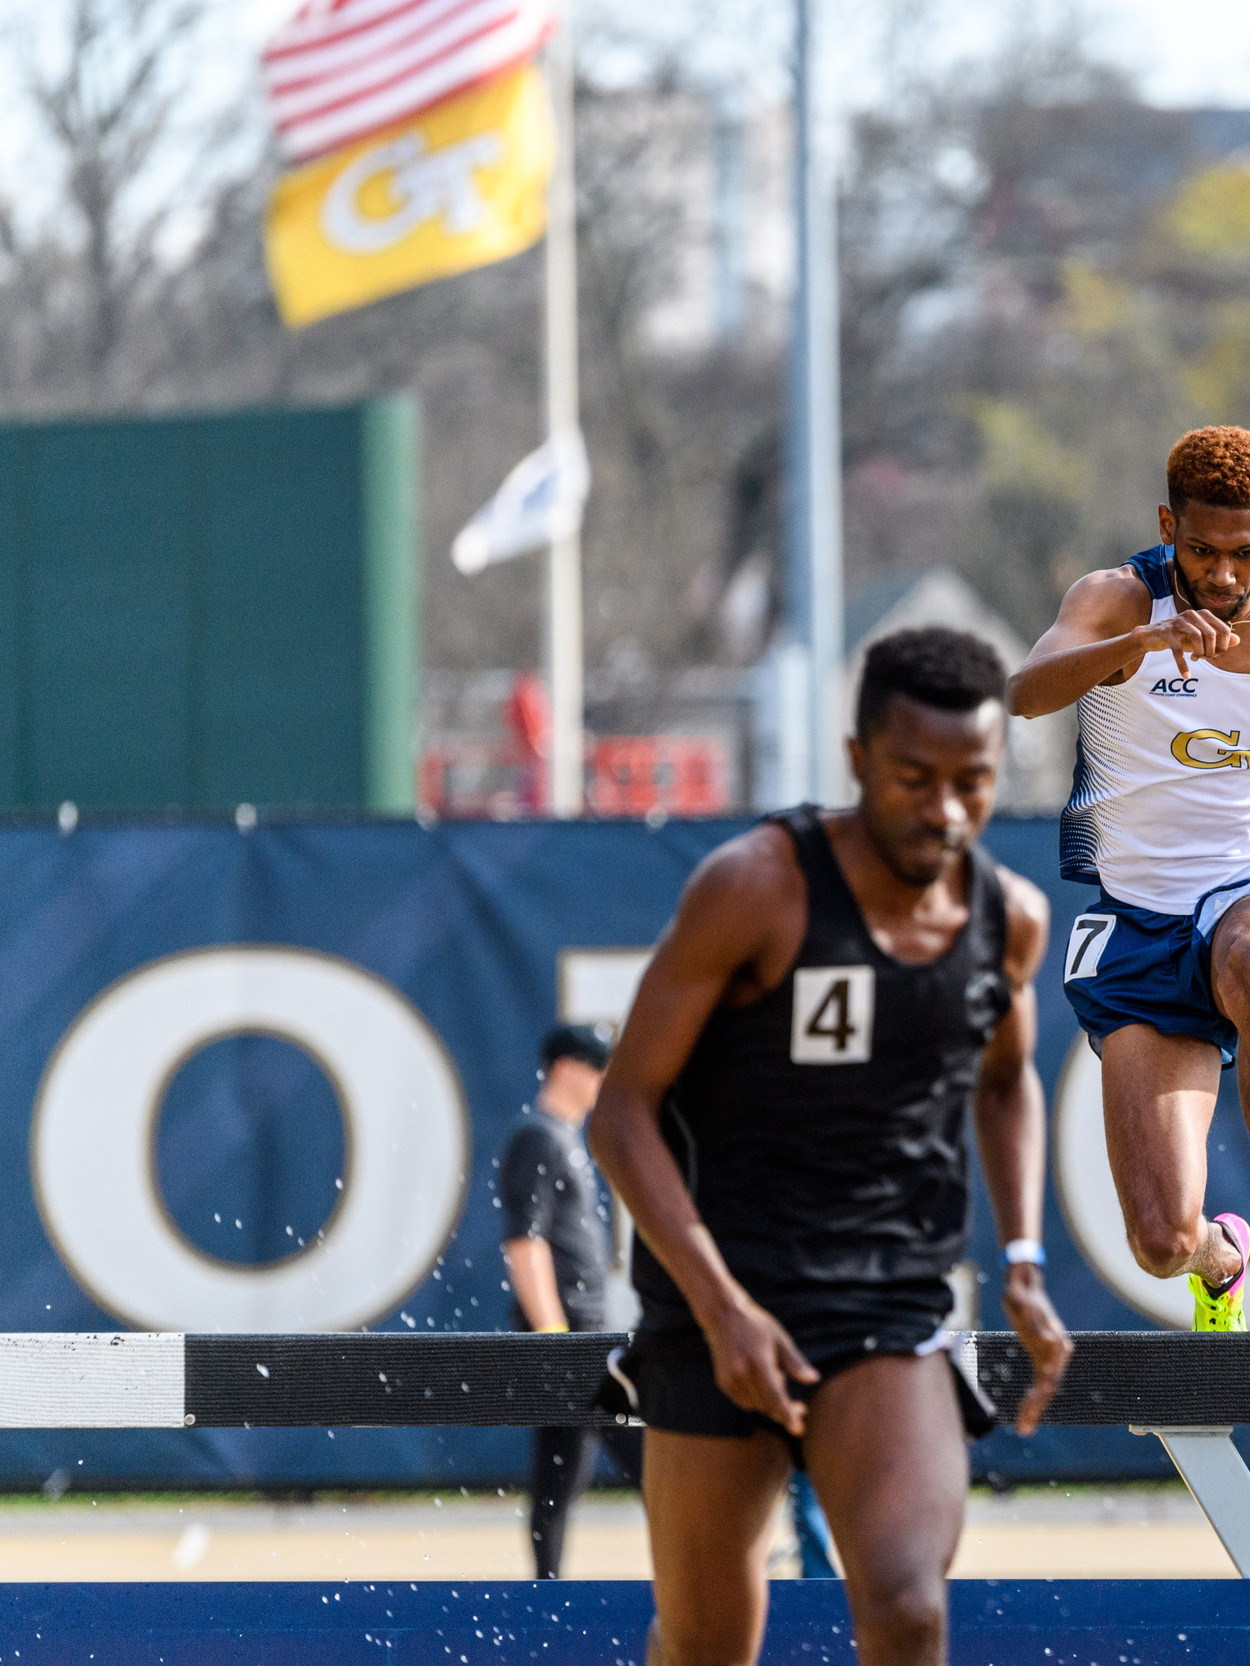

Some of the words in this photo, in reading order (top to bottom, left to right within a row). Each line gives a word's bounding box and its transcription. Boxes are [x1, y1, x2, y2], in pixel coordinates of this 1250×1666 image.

[322, 131, 502, 254] GT
[1150, 678, 1199, 693] ACC
[1069, 919, 1109, 976] 7
[806, 978, 856, 1051] 4
